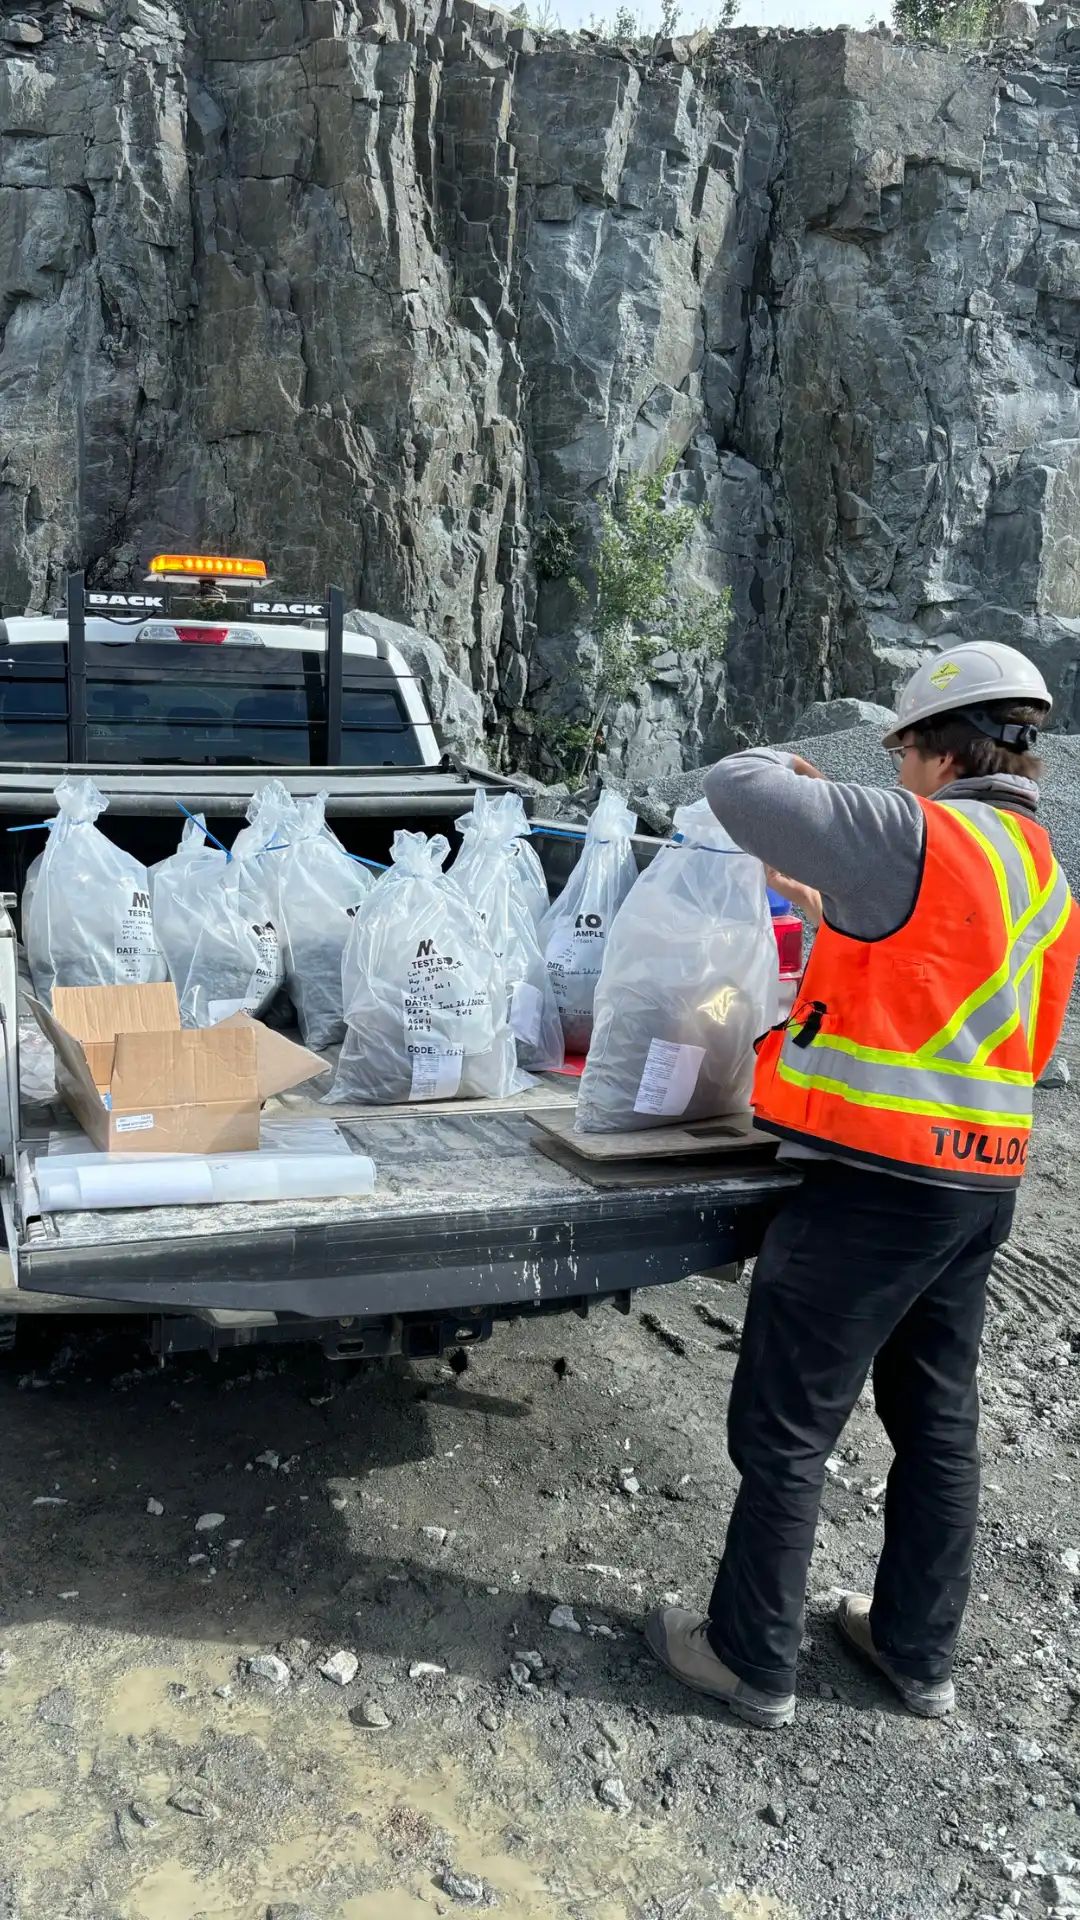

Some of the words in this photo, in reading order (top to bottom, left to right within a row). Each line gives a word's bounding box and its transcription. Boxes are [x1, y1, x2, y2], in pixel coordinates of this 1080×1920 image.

[89, 593, 164, 607] BACK
[253, 602, 322, 615] RACK
[574, 930, 605, 938] AMPLE
[412, 958, 434, 969] TEST
[405, 999, 432, 1008] DATE:
[407, 1045, 436, 1054] CODE:
